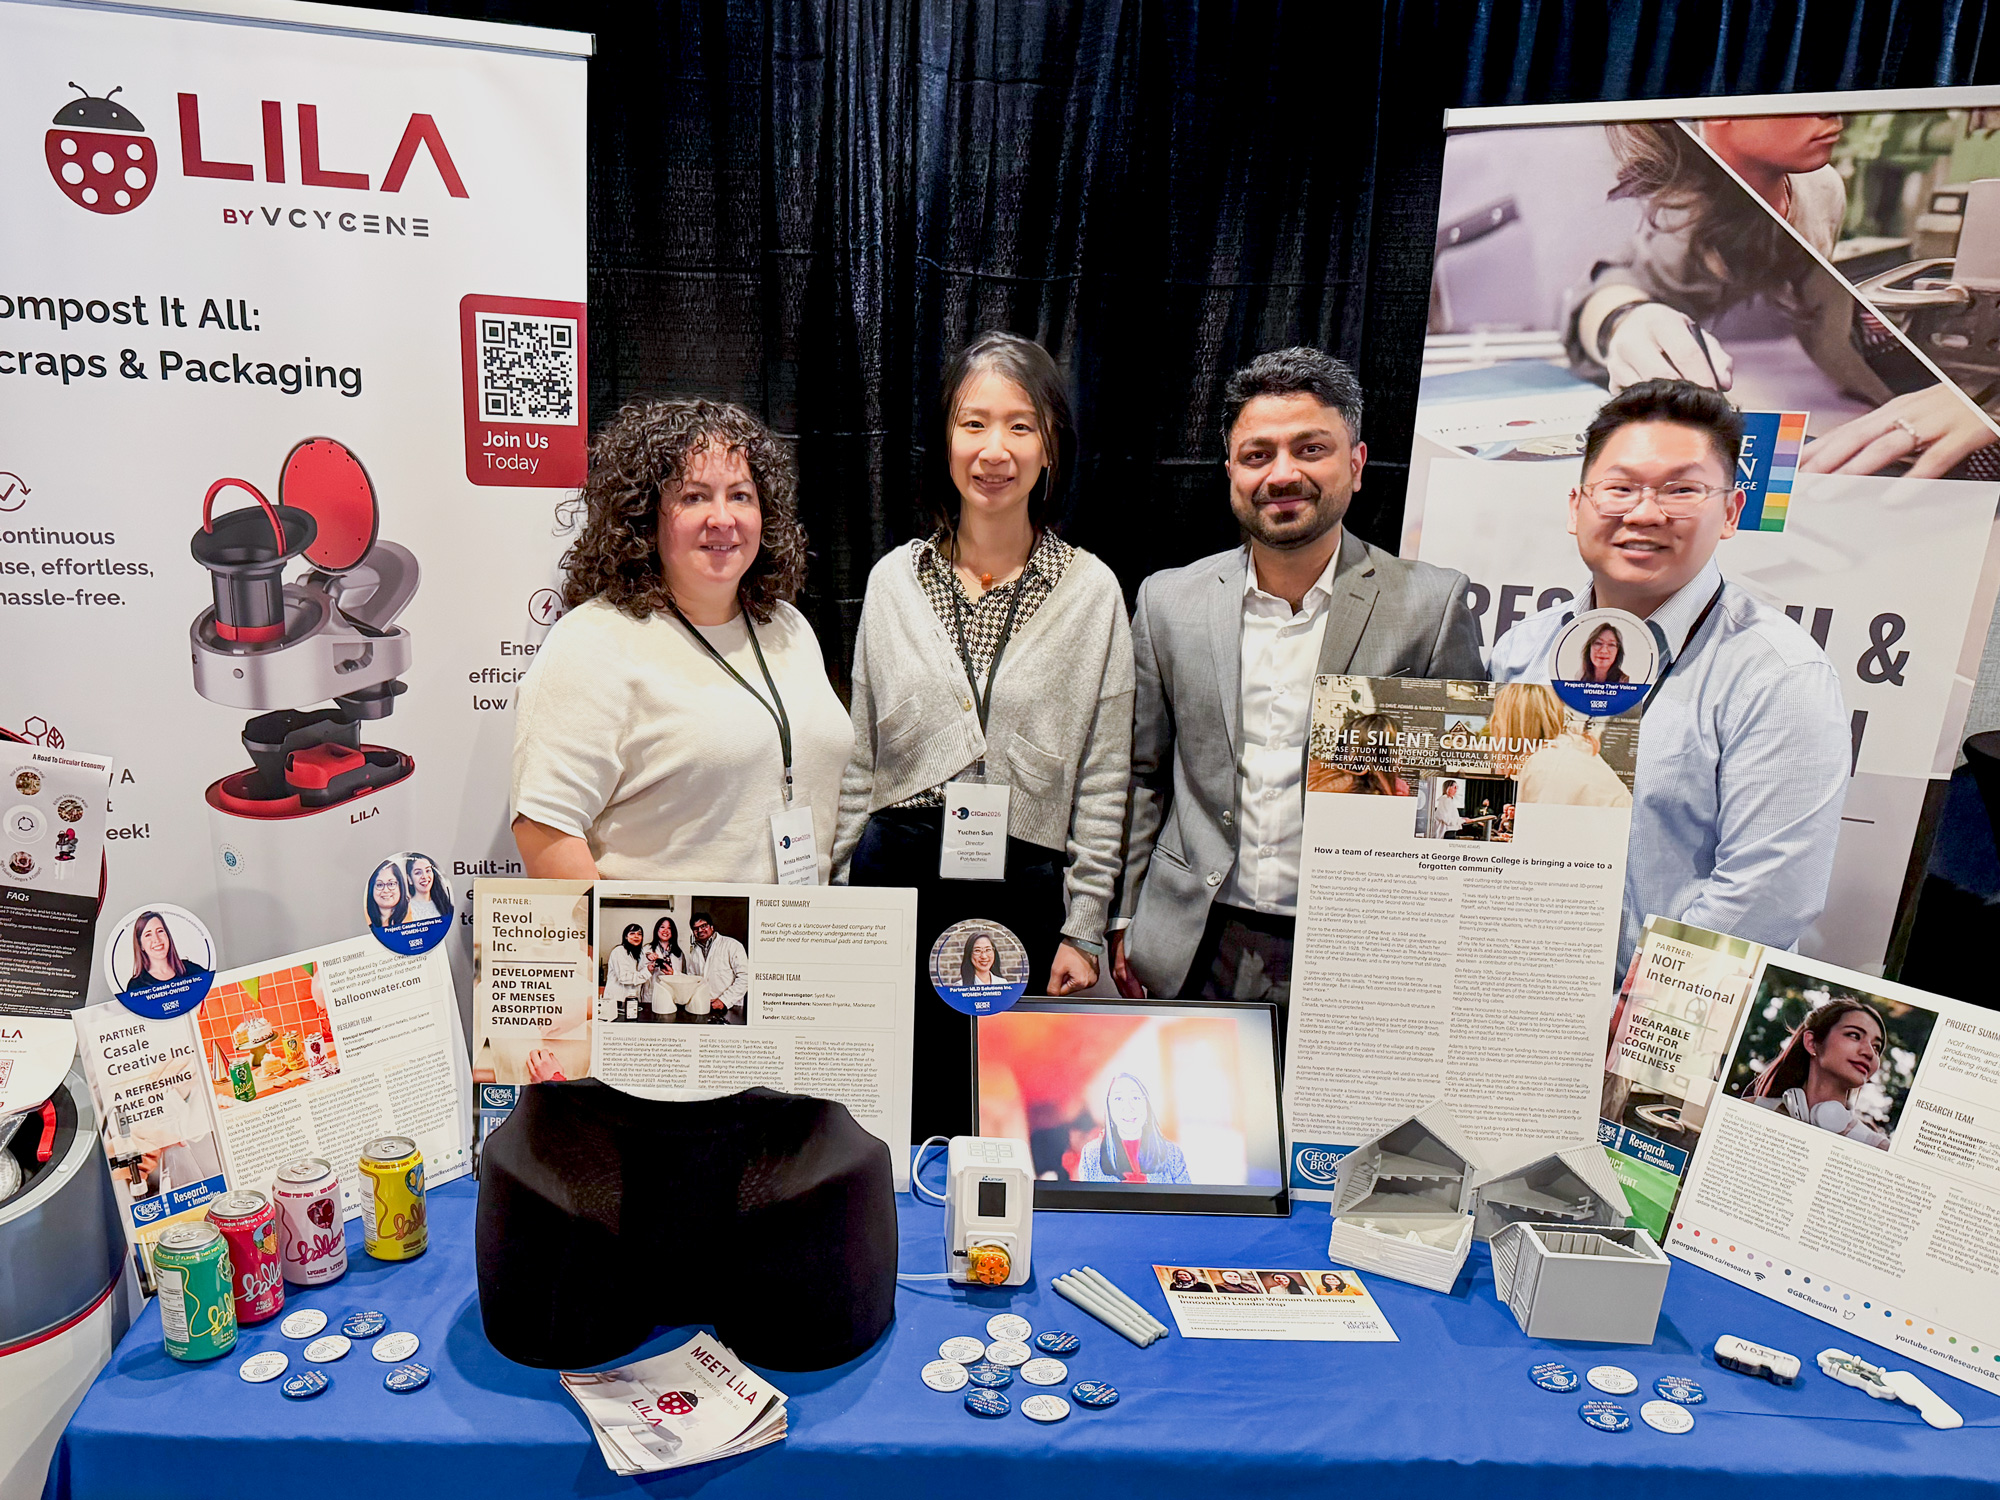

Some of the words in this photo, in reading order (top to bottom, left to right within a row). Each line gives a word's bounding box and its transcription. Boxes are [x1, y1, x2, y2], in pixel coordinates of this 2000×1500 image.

[177, 92, 470, 198] LILA
[223, 208, 254, 225] BY
[0, 295, 149, 331] ompost
[160, 295, 188, 328] It
[198, 298, 261, 331] All:
[0, 351, 108, 385] craps
[119, 348, 148, 380] &
[159, 350, 363, 398] Packaging
[482, 430, 521, 448] Join
[525, 432, 549, 449] Us
[483, 452, 540, 475] Today
[0, 526, 116, 545] ontinuous
[41, 558, 154, 578] effortless,
[1856, 612, 1910, 687] &
[473, 695, 508, 710] low
[1323, 728, 1360, 745] THE
[1367, 730, 1434, 748] SILENT
[1439, 734, 1557, 753] COMMUNIT
[1320, 753, 1377, 763] PRESERVATION
[1379, 756, 1403, 764] USING
[1419, 758, 1436, 766] AND
[1464, 761, 1506, 770] SCANNING
[1328, 745, 1349, 753] CASE
[1389, 748, 1439, 758] INDIGENOUS
[1440, 751, 1480, 760] CULTURAL
[37, 754, 52, 764] Road
[58, 757, 80, 767] Circular
[80, 760, 106, 771] Economy
[1336, 763, 1371, 771] OTTAWA
[1372, 765, 1403, 773] VALLEY
[120, 768, 136, 784] A
[350, 806, 380, 825] LILA
[453, 859, 522, 876] Built-in
[1342, 848, 1362, 856] team
[1364, 849, 1373, 857] of
[1374, 850, 1419, 859] researchers
[1421, 852, 1429, 860] at
[1431, 853, 1461, 863] George
[1462, 855, 1489, 863] Brown
[1490, 856, 1521, 866] College
[1530, 858, 1565, 868] bringing
[1573, 861, 1595, 869] voice
[1418, 862, 1457, 871] forgotten
[1458, 864, 1504, 875] community
[6, 891, 31, 902] FAQs
[492, 897, 532, 905] PARTNER:
[756, 899, 780, 907] PROJECT
[781, 900, 811, 908] SUMMARY
[492, 911, 533, 924] Revol
[492, 925, 587, 942] Technologies
[779, 929, 824, 937] high-absorbency
[492, 940, 517, 952] Inc.
[1655, 942, 1695, 959] PARTNER:
[1651, 953, 1686, 972] NOIT
[491, 968, 575, 978] DEVELOPMENT
[755, 973, 785, 981] RESEARCH
[786, 973, 802, 981] TEAM
[152, 983, 170, 993] Casale
[170, 979, 192, 988] Creative
[192, 976, 203, 984] Inc.
[333, 976, 422, 1007] balloonwater.com
[491, 980, 517, 989] AND
[520, 981, 553, 990] TRIAL
[1646, 968, 1736, 1005] International
[491, 992, 507, 1001] OF
[509, 993, 556, 1002] MENSES
[491, 1004, 563, 1014] ABSORPTION
[336, 1018, 361, 1032] RESEARCH
[360, 1016, 373, 1026] TEAM
[491, 1016, 553, 1027] STANDARD
[1631, 1013, 1691, 1041] WEARABLE
[1944, 1018, 1977, 1035] PROJECT
[1977, 1027, 2000, 1042] SUMM
[99, 1024, 146, 1044] PARTNER
[1628, 1024, 1655, 1041] TECH
[1656, 1035, 1679, 1049] FOR
[103, 1038, 150, 1060] Casale
[1624, 1036, 1683, 1063] COGNITIVE
[107, 1052, 167, 1077] Creative
[171, 1045, 195, 1059] Inc.
[1621, 1047, 1676, 1073] WELLNESS
[114, 1092, 123, 1102] A
[125, 1071, 193, 1098] REFRESHING
[115, 1097, 148, 1114] TAKE
[147, 1092, 164, 1104] ON
[1915, 1098, 1954, 1118] RESEARCH
[1954, 1110, 1975, 1125] TEAM
[119, 1106, 164, 1127] SELTZER
[1919, 1126, 1947, 1139] Research
[1947, 1135, 1977, 1149] Assistant:
[1922, 1119, 1948, 1132] Principal
[1948, 1128, 1988, 1146] Investigator:
[1628, 1133, 1666, 1158] Research
[1915, 1138, 1936, 1150] Project
[1936, 1147, 1974, 1163] Coordinator:
[1918, 1132, 1942, 1144] Student
[1942, 1141, 1977, 1156] Researcher:
[1304, 1150, 1350, 1162] GEORG
[1637, 1150, 1642, 1158] &
[1643, 1152, 1676, 1171] Innovation
[1309, 1160, 1340, 1171] BRO
[173, 1182, 209, 1204] Research
[191, 1190, 221, 1206] Innovation
[1671, 1237, 1752, 1277] georgebrown.ca/research
[1787, 1286, 1838, 1314] @GBCResearch
[690, 1345, 731, 1378] MEET
[726, 1375, 758, 1405] LILA
[631, 1398, 663, 1428] LILA
